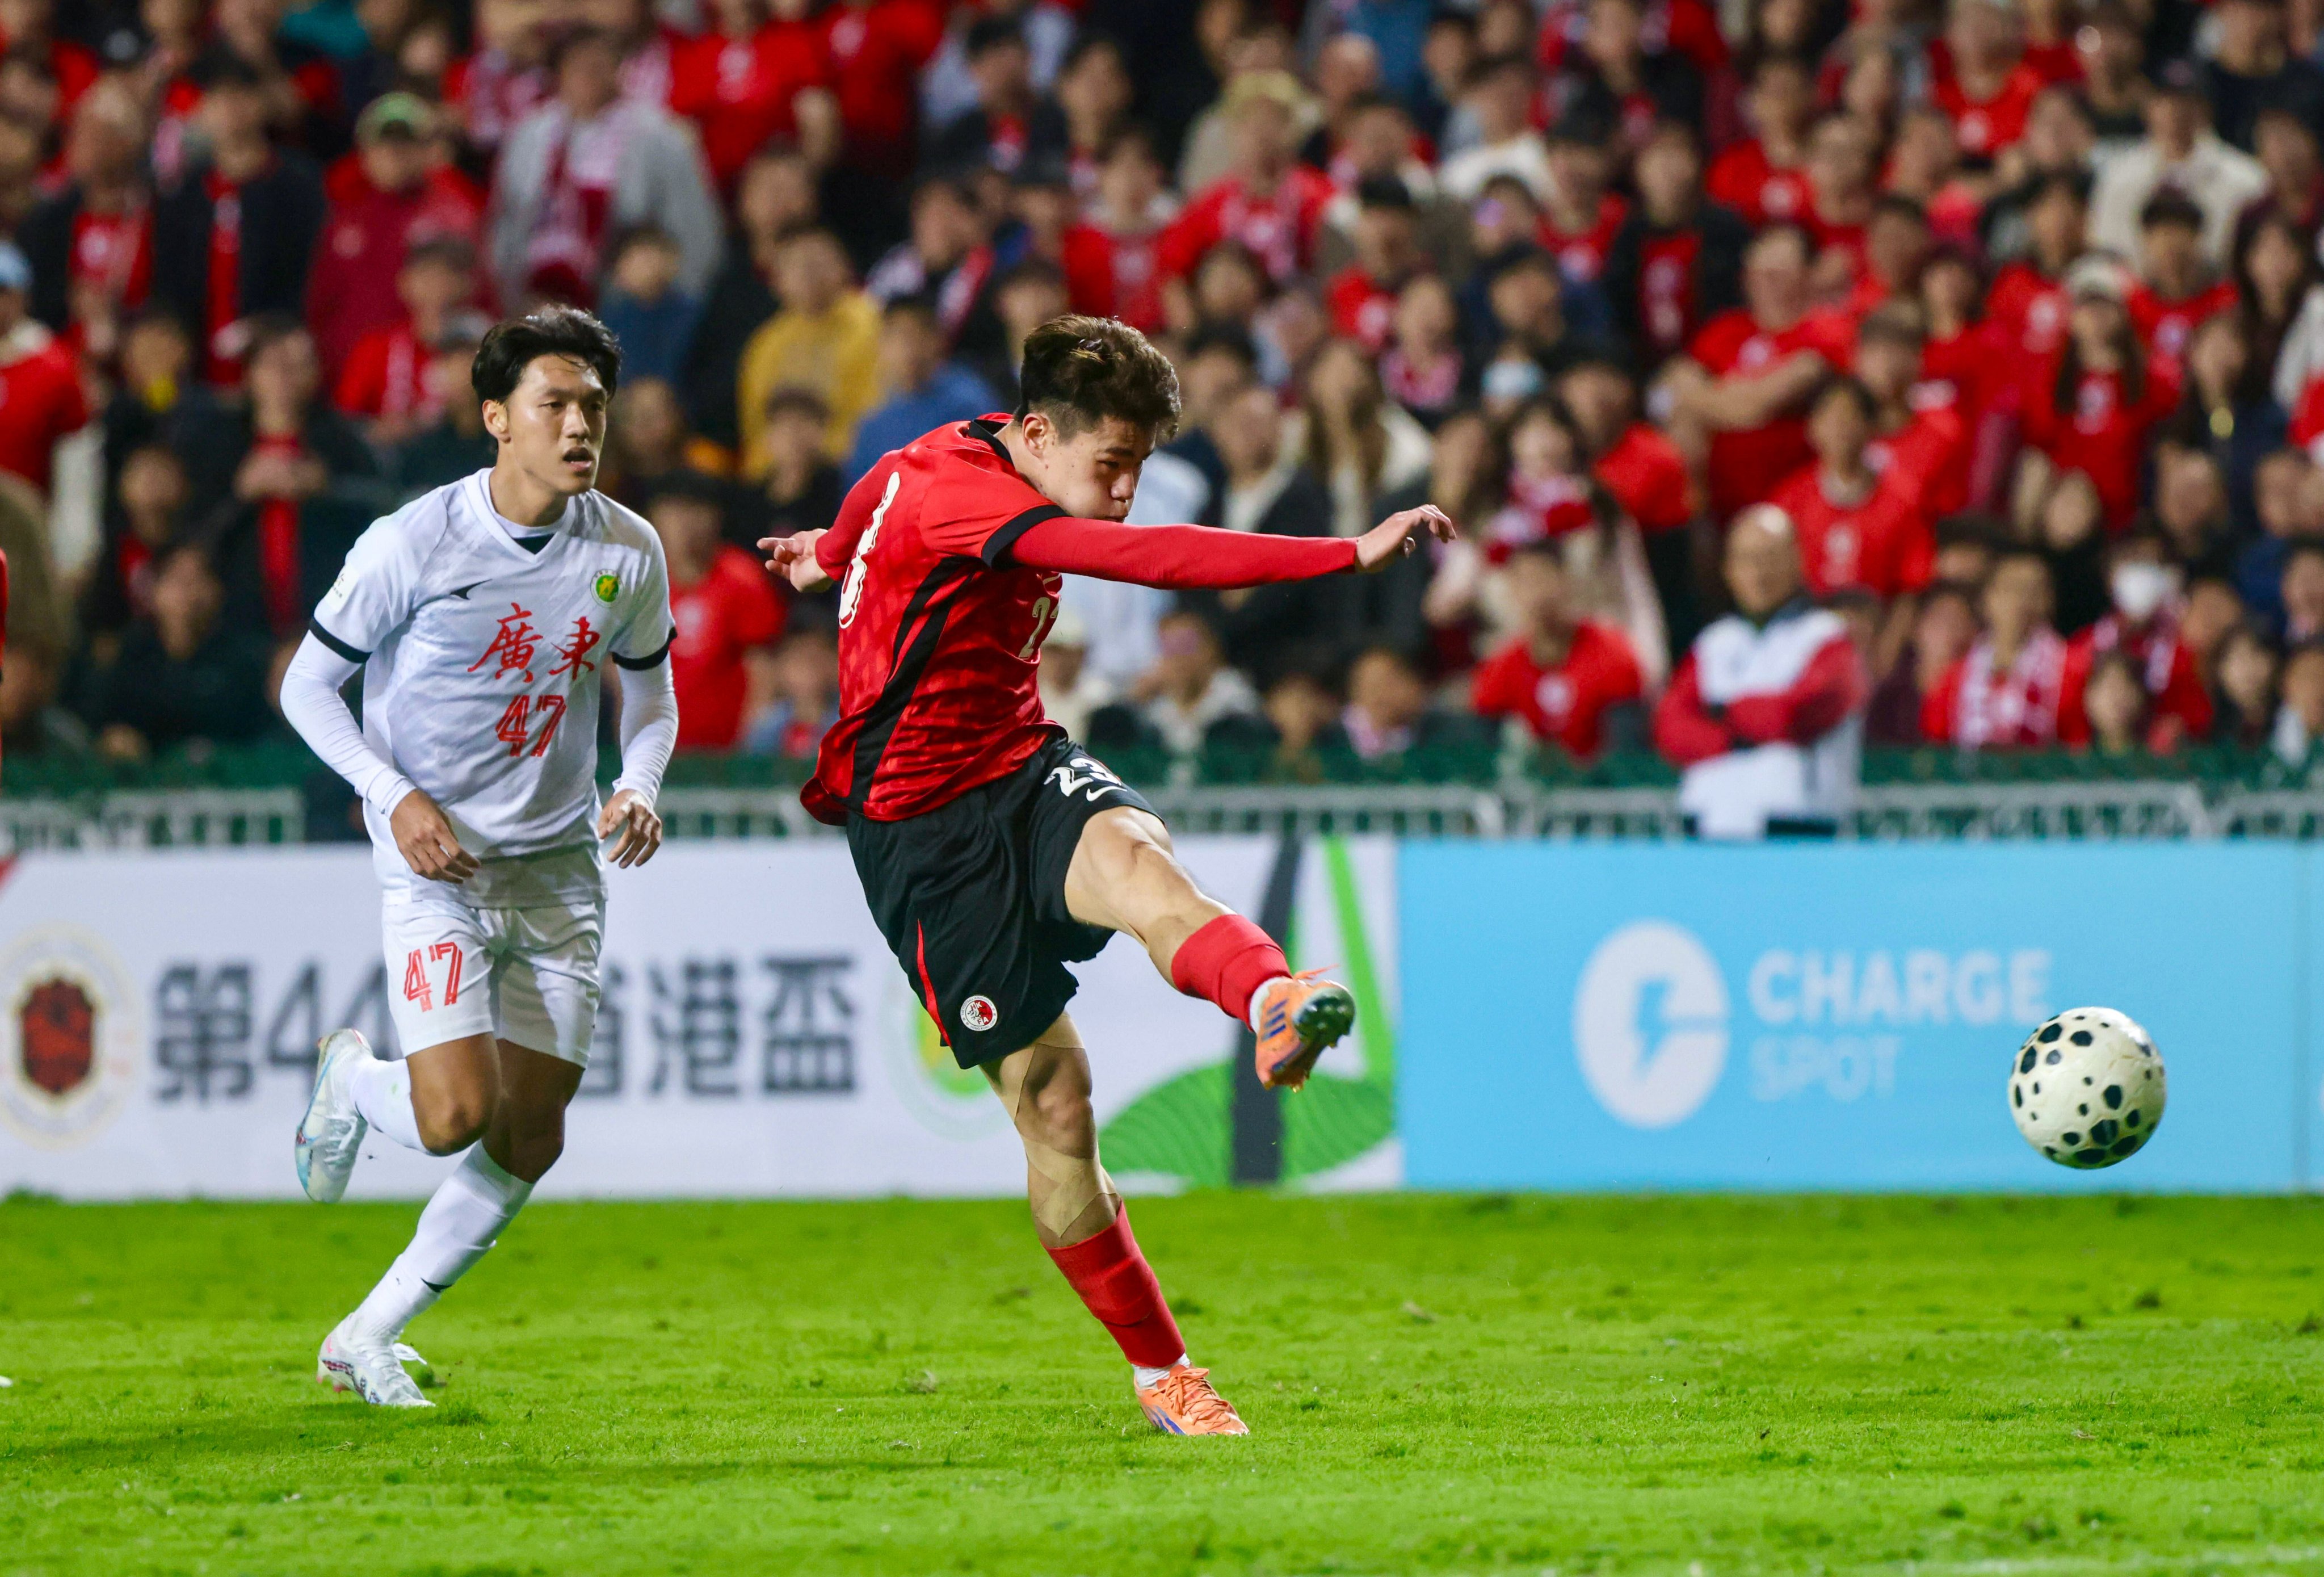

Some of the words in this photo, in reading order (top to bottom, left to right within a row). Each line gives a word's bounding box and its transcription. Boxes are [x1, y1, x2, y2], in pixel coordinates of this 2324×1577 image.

[467, 602, 600, 683] 廣東
[1018, 597, 1060, 660] 2
[495, 694, 566, 757] 47
[1043, 757, 1122, 797] 23
[404, 942, 463, 1012] 47
[1749, 948, 2053, 1026] CHARGE
[1748, 1034, 1901, 1102] SPOT
